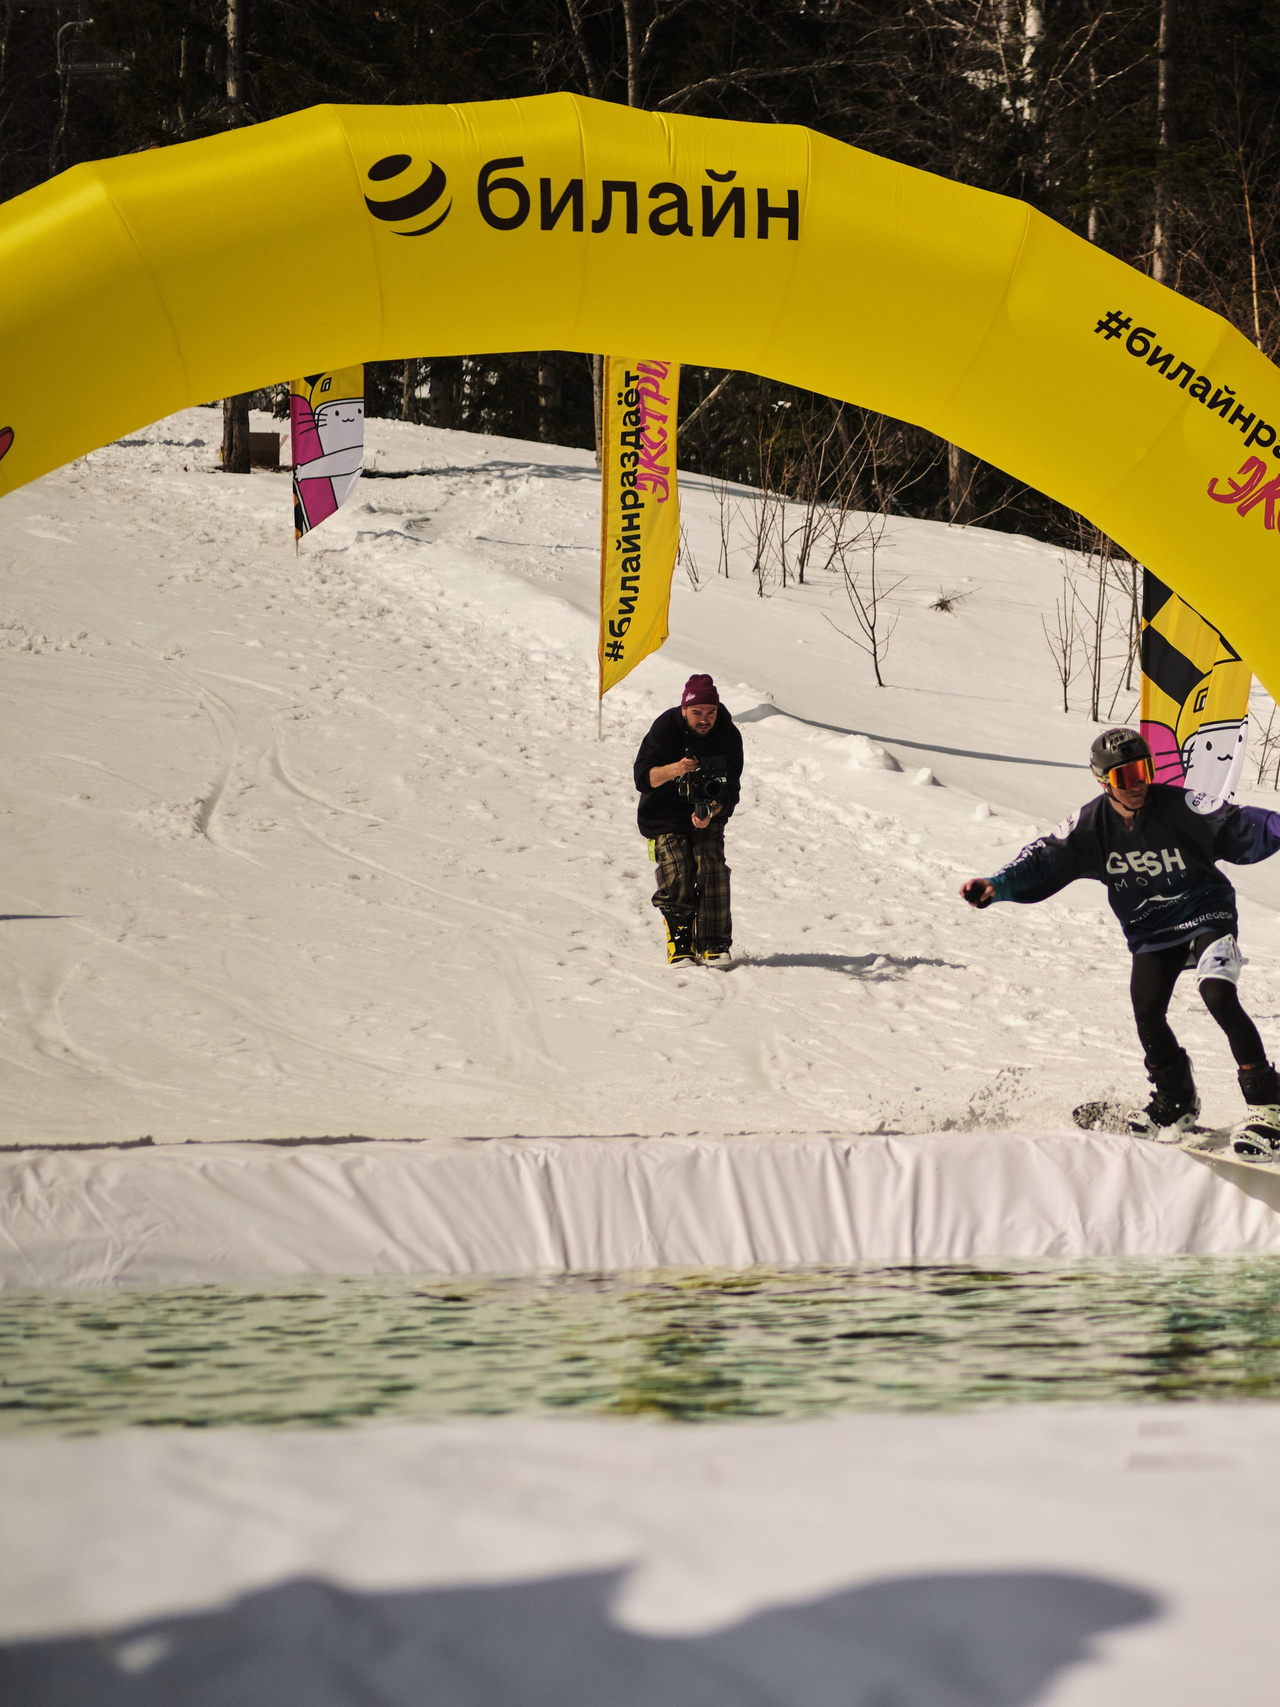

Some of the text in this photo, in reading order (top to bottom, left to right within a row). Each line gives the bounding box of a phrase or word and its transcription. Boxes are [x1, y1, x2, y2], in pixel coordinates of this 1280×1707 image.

[477, 156, 799, 241] билайн
[633, 358, 672, 503] ЭКСТРИ
[604, 370, 645, 662] #билайнраздаёт
[1106, 848, 1186, 877] GESH
